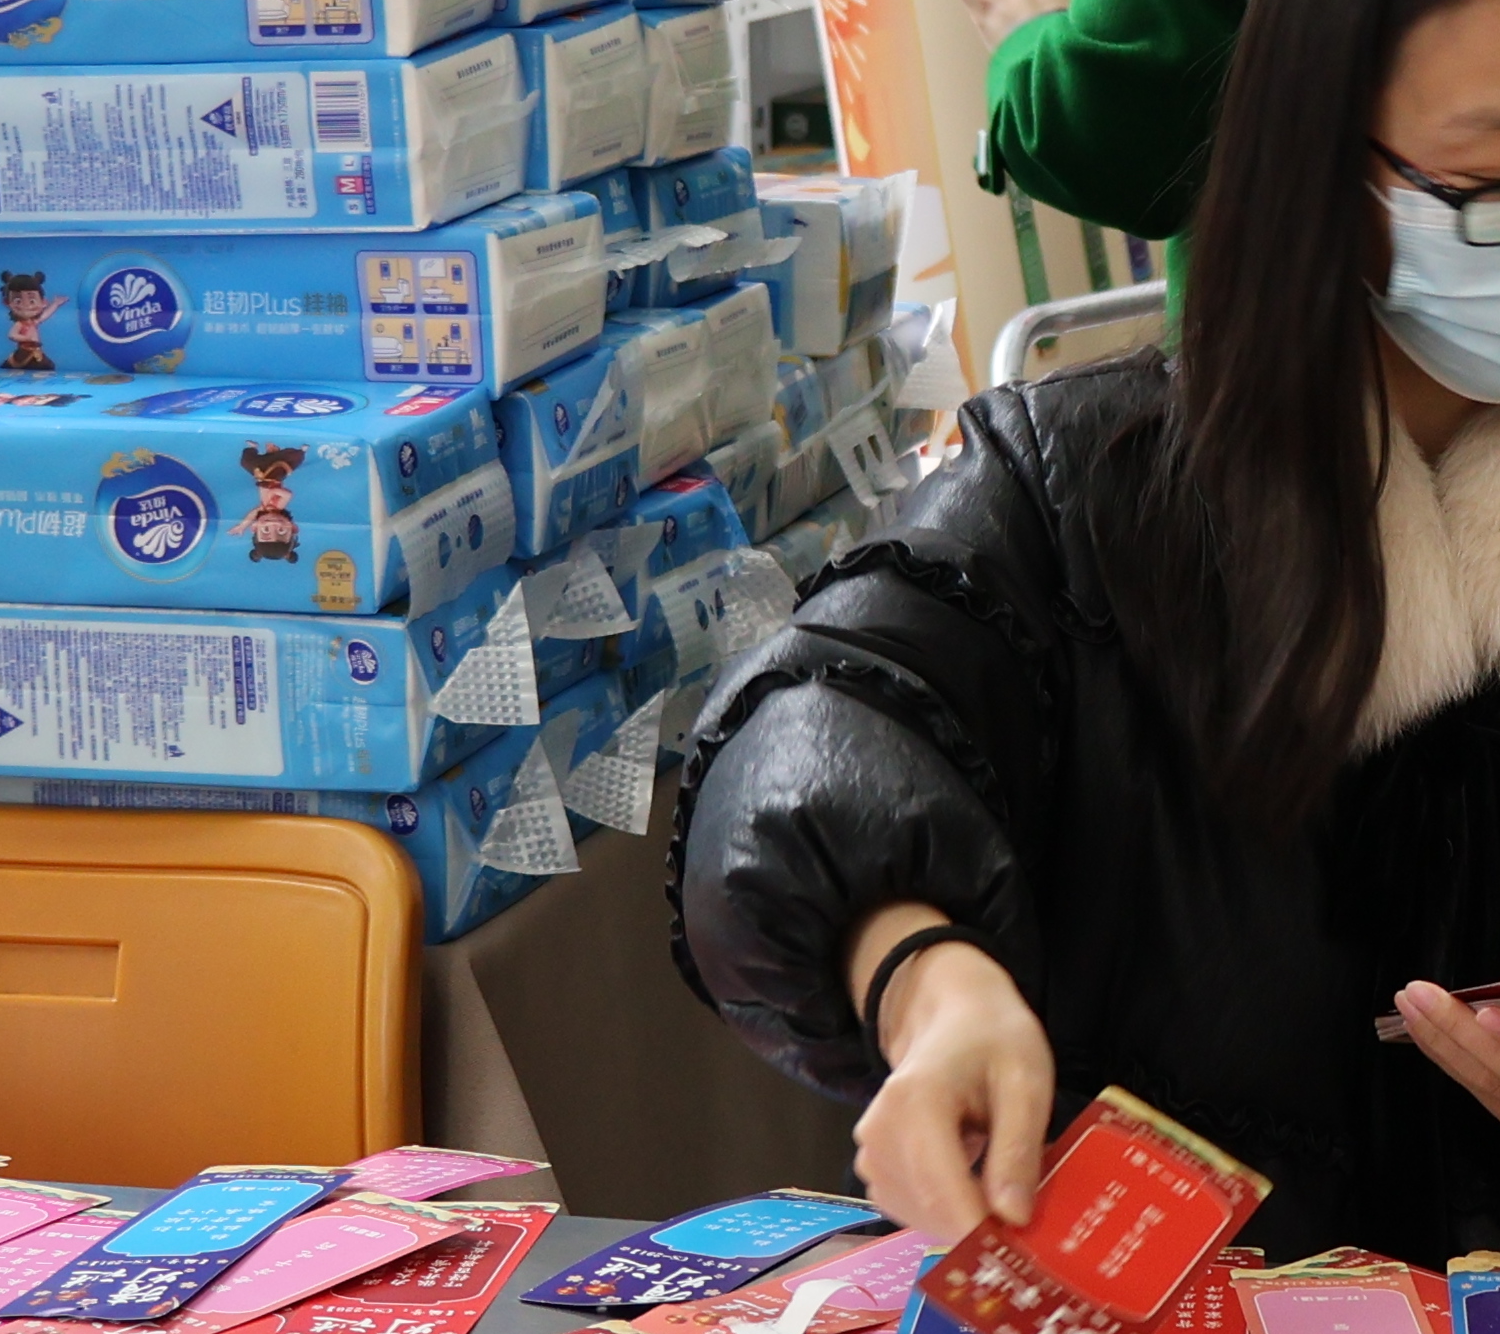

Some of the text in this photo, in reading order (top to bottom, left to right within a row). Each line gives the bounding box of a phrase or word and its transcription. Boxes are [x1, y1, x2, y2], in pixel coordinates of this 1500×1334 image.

[340, 177, 356, 193] M
[111, 299, 163, 326] Vinda
[202, 290, 349, 317] 超韧Plus挂抽
[125, 317, 153, 334] 维达
[129, 503, 184, 528] Vinda
[137, 494, 168, 512] 维达
[60, 1266, 184, 1307] 猜灯谜
[596, 1256, 712, 1305] 猜灯谜
